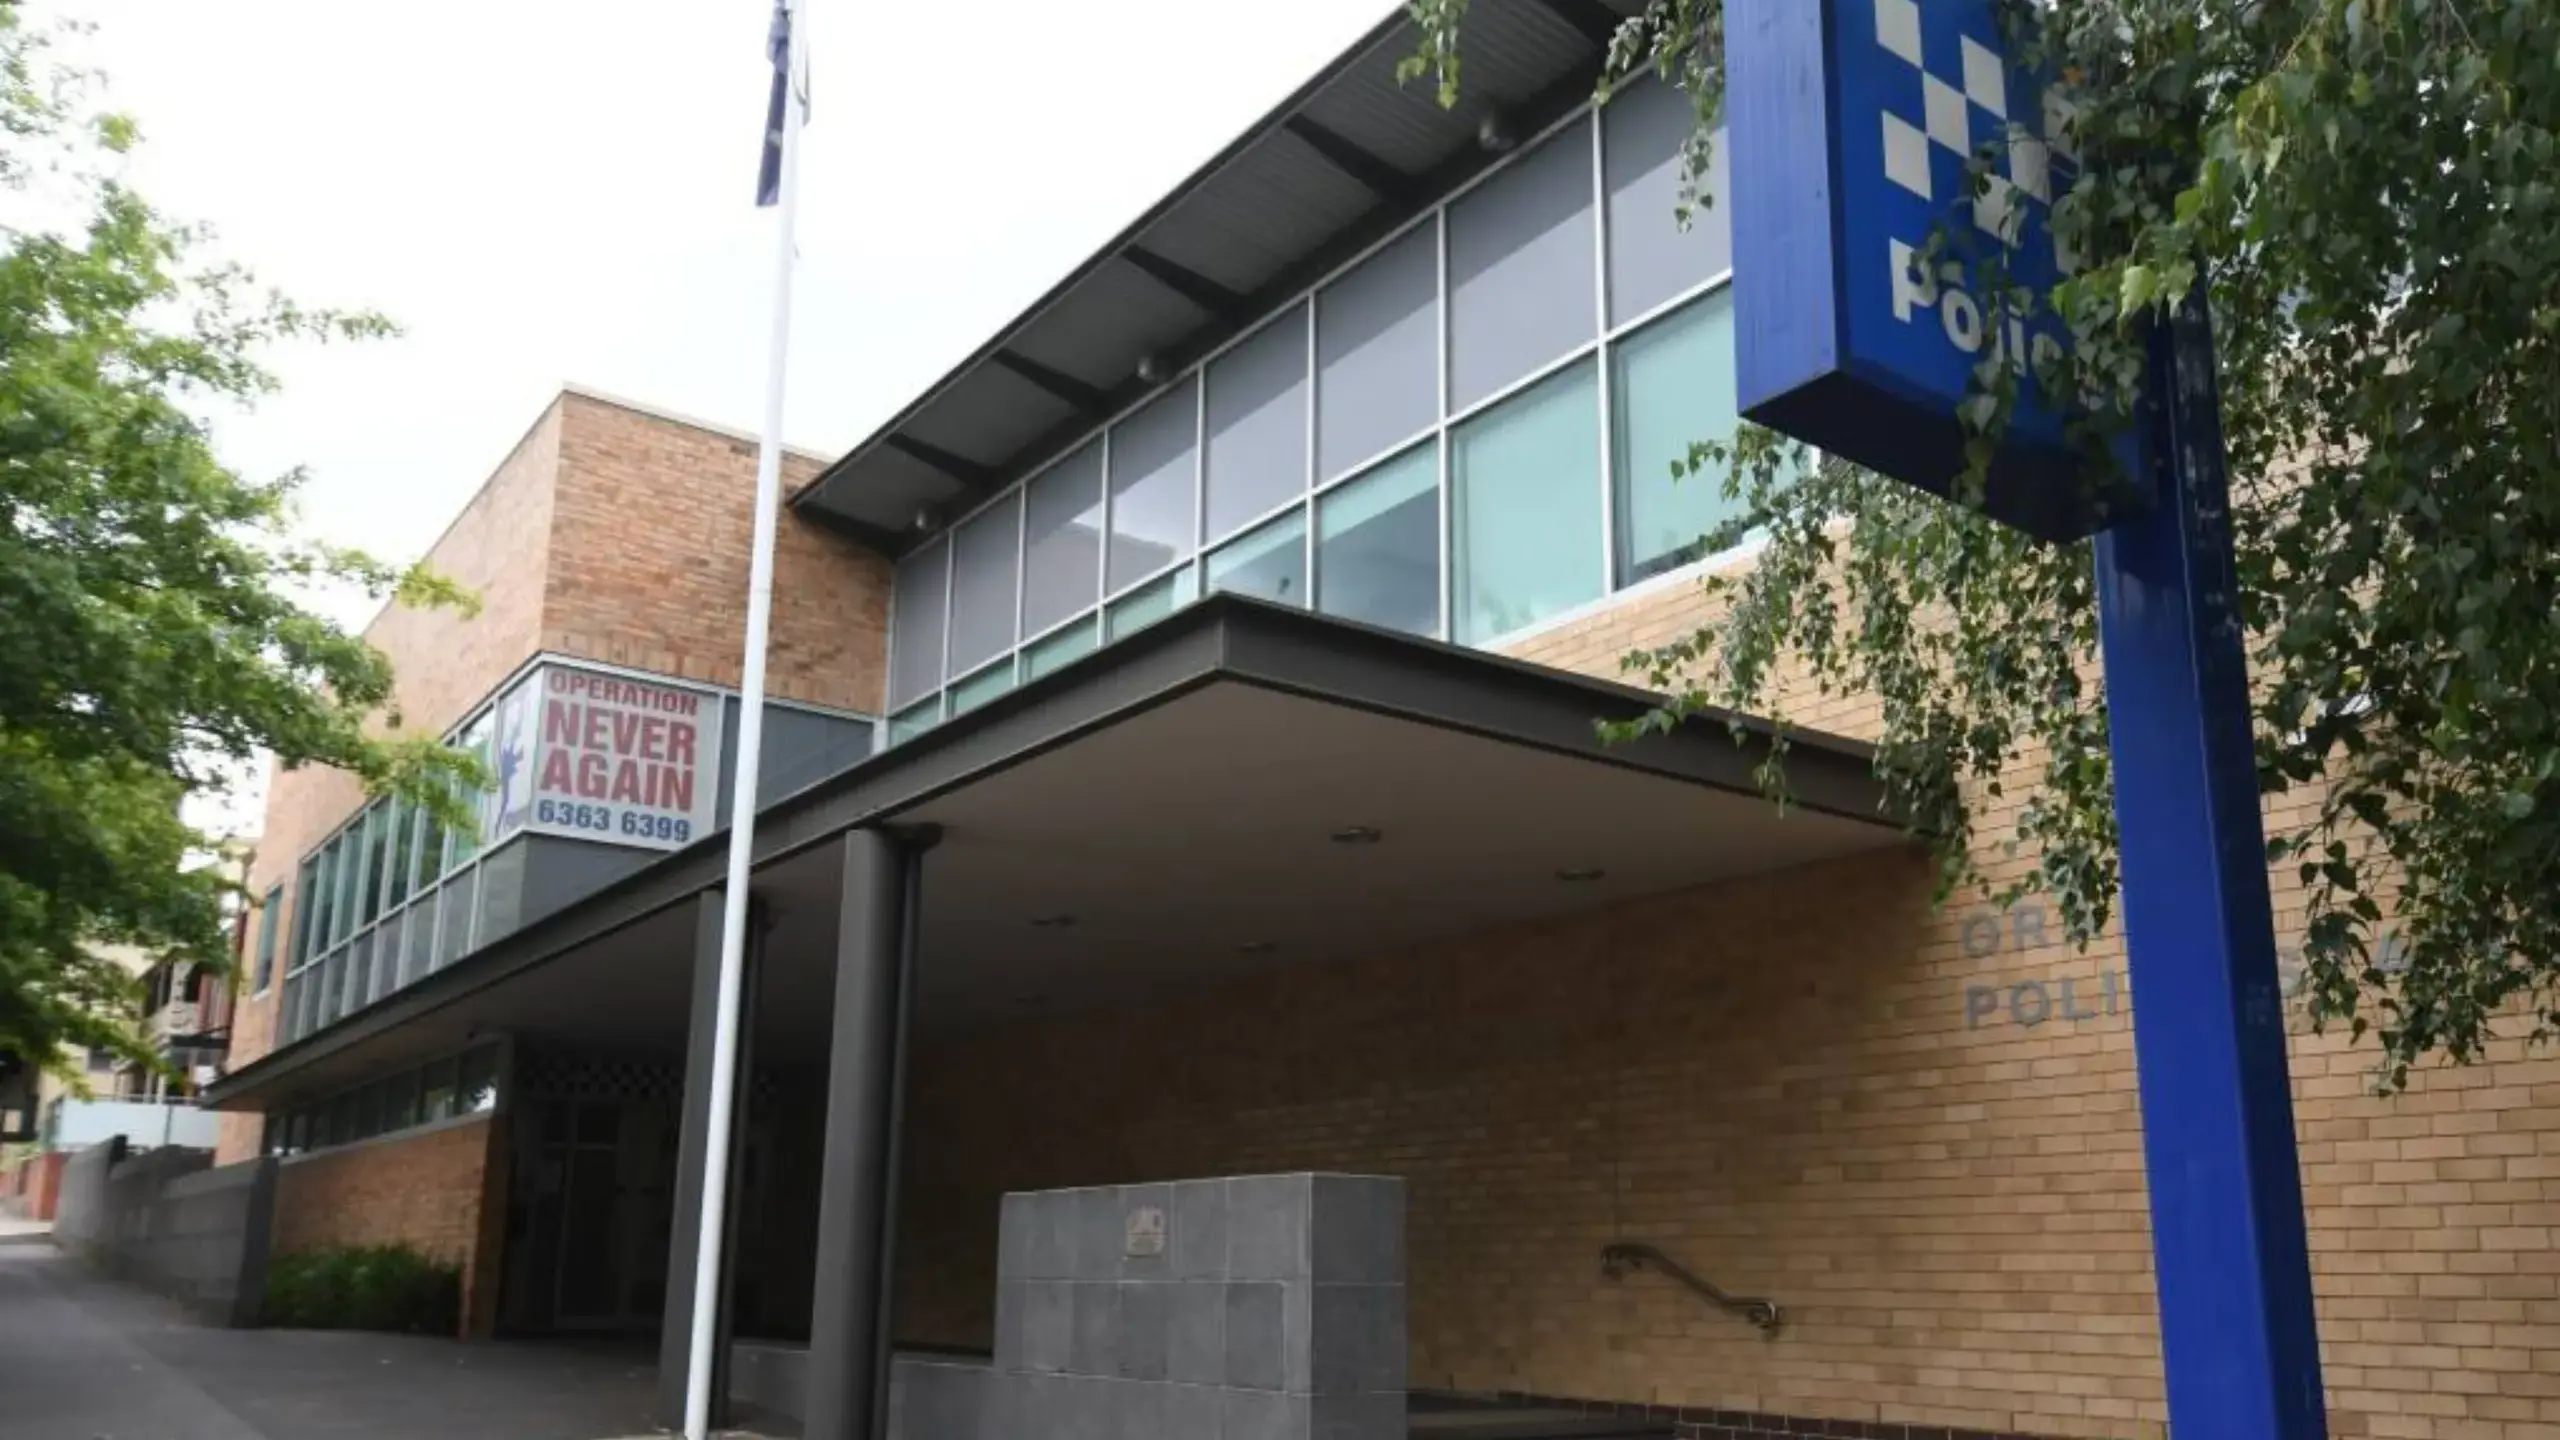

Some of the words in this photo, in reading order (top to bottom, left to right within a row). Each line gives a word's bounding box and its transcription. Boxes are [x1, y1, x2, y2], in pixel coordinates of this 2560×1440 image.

[550, 671, 698, 716] OPERATION
[546, 700, 696, 766] NEVER
[540, 748, 694, 813] AGAIN
[538, 799, 611, 831] 6363
[621, 810, 691, 843] 6399
[1966, 969, 2118, 1031] POLI
